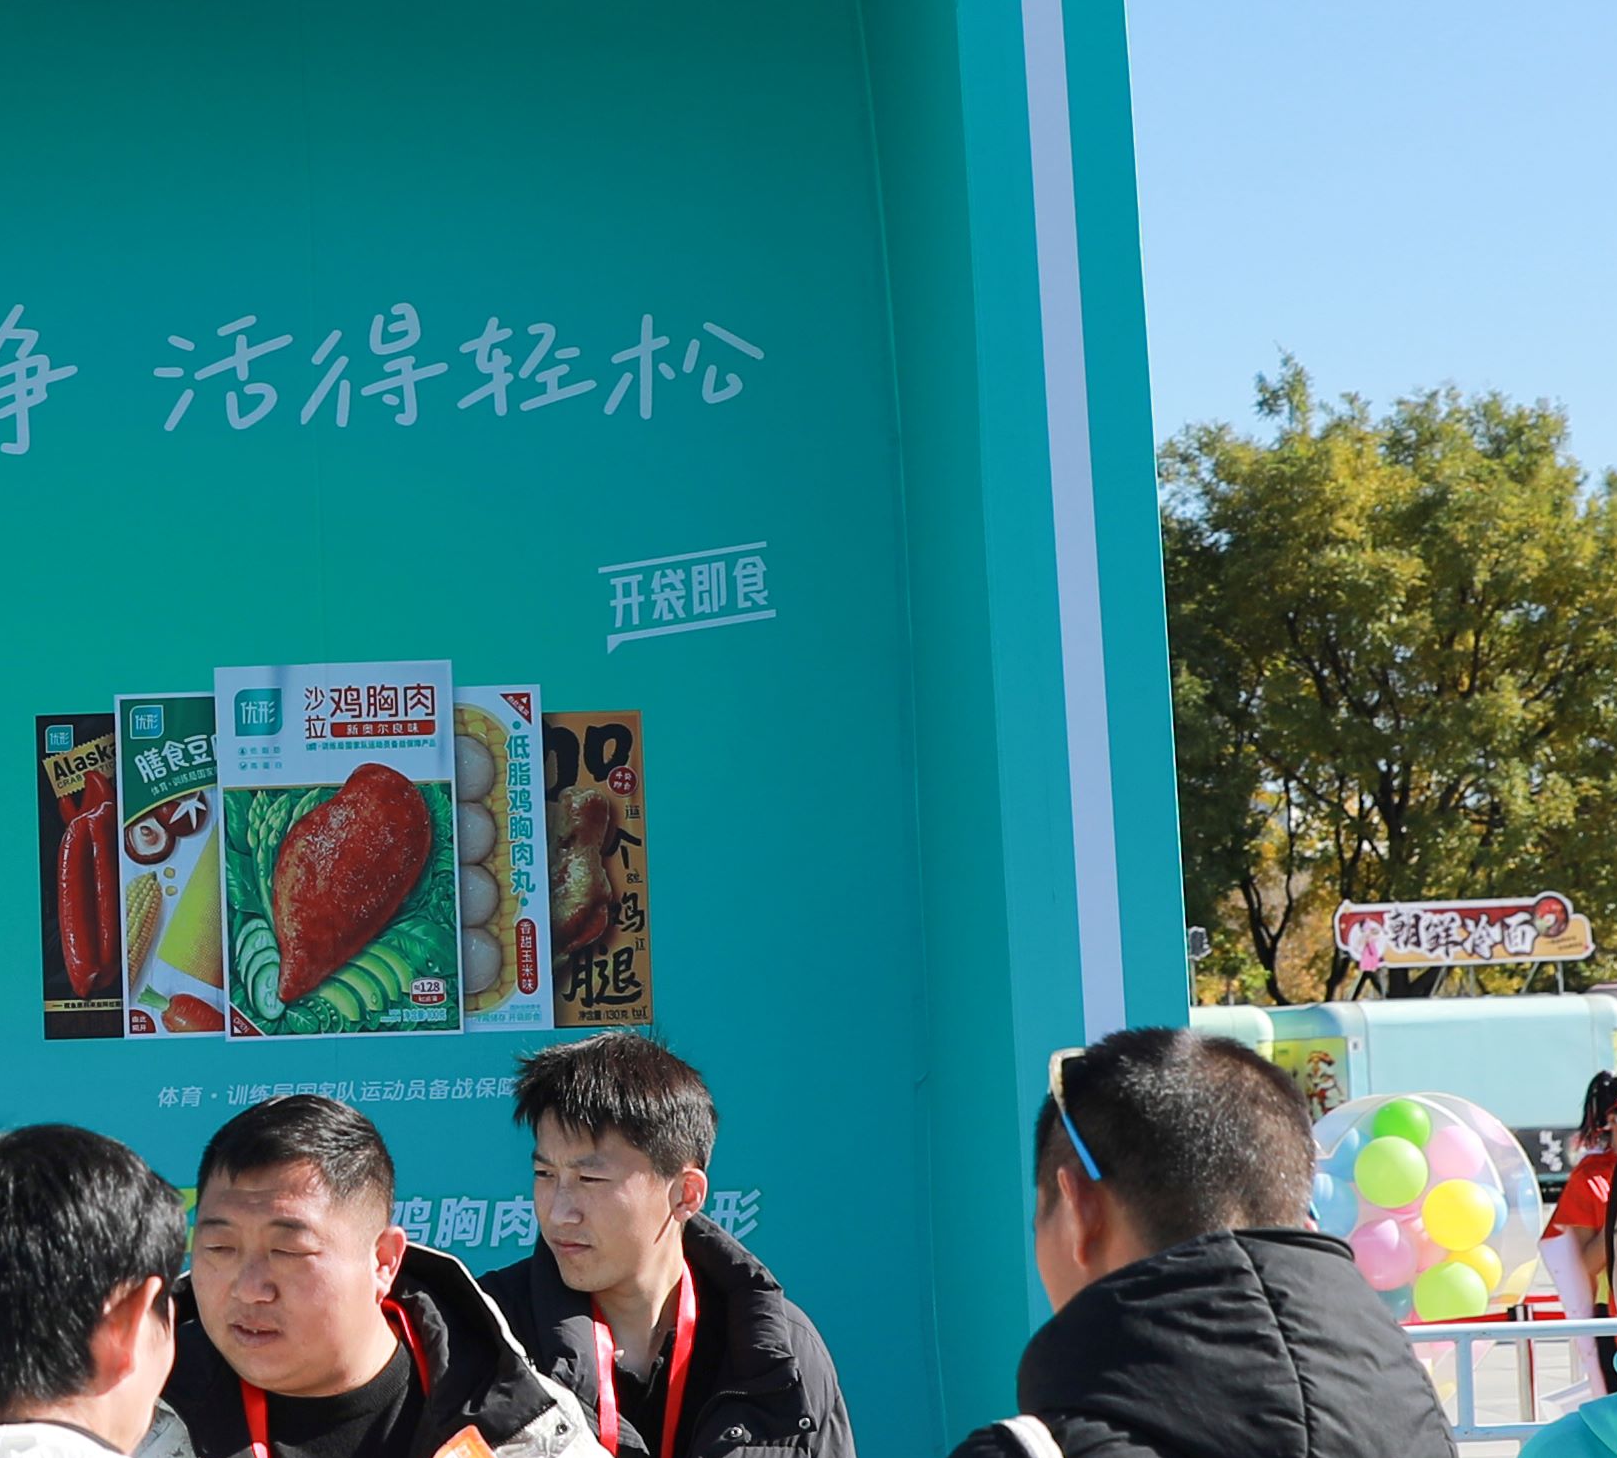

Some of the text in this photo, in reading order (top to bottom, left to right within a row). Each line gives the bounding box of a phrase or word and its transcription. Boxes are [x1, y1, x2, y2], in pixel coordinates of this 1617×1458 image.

[152, 301, 765, 434] 活得轻松
[610, 555, 768, 628] 开袋即食
[330, 682, 436, 719] 鸡胸肉
[505, 734, 536, 893] 低脂鸡胸肉丸
[1388, 907, 1538, 960] 朝鲜冷面
